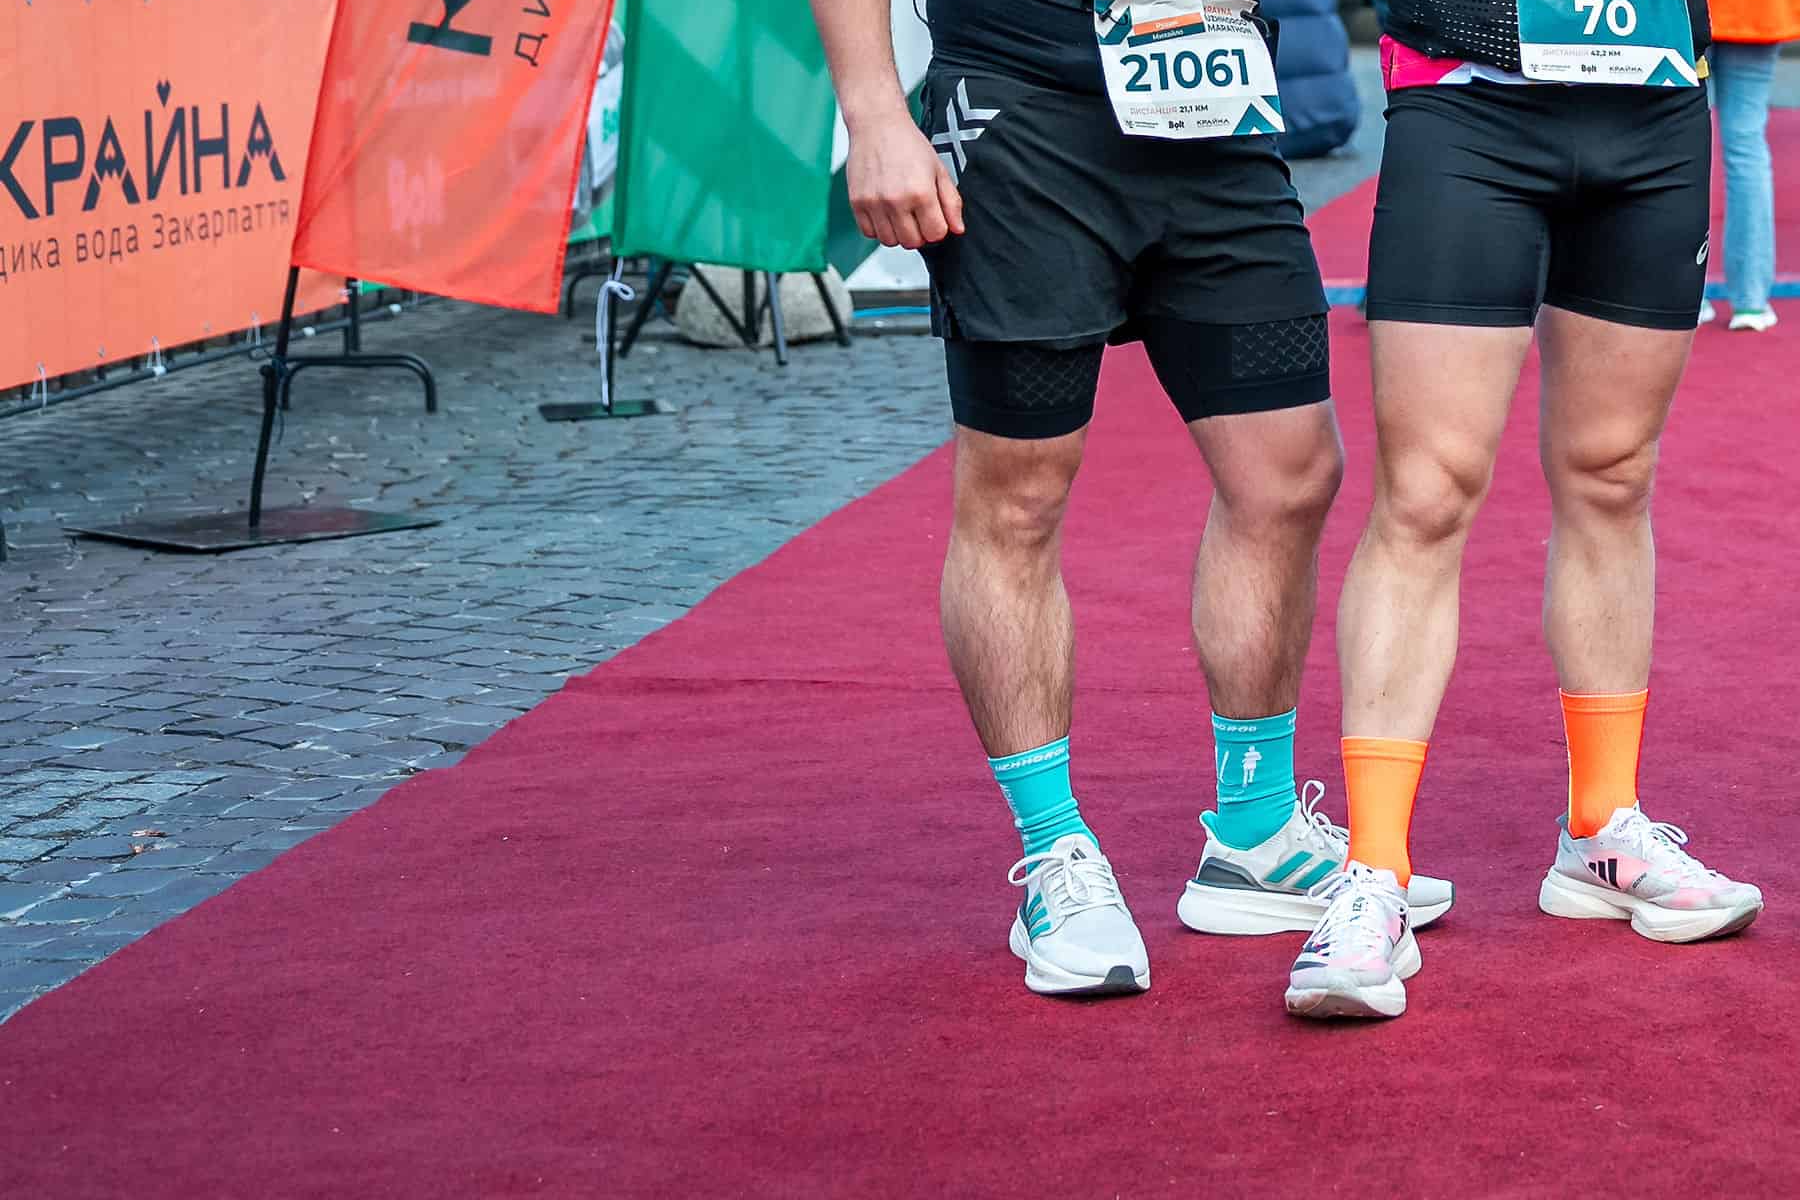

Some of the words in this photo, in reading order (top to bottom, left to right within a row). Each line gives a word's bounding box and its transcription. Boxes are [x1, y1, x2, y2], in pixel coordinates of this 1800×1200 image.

[1590, 49, 1607, 58] 42,2
[1119, 48, 1250, 92] 21061
[1581, 63, 1597, 76] Bolt
[1179, 104, 1194, 114] 21,1
[1168, 119, 1185, 130] Bolt
[0, 80, 286, 219] КРАЙНА
[75, 222, 140, 265] вода
[152, 199, 290, 250] Закарпаття
